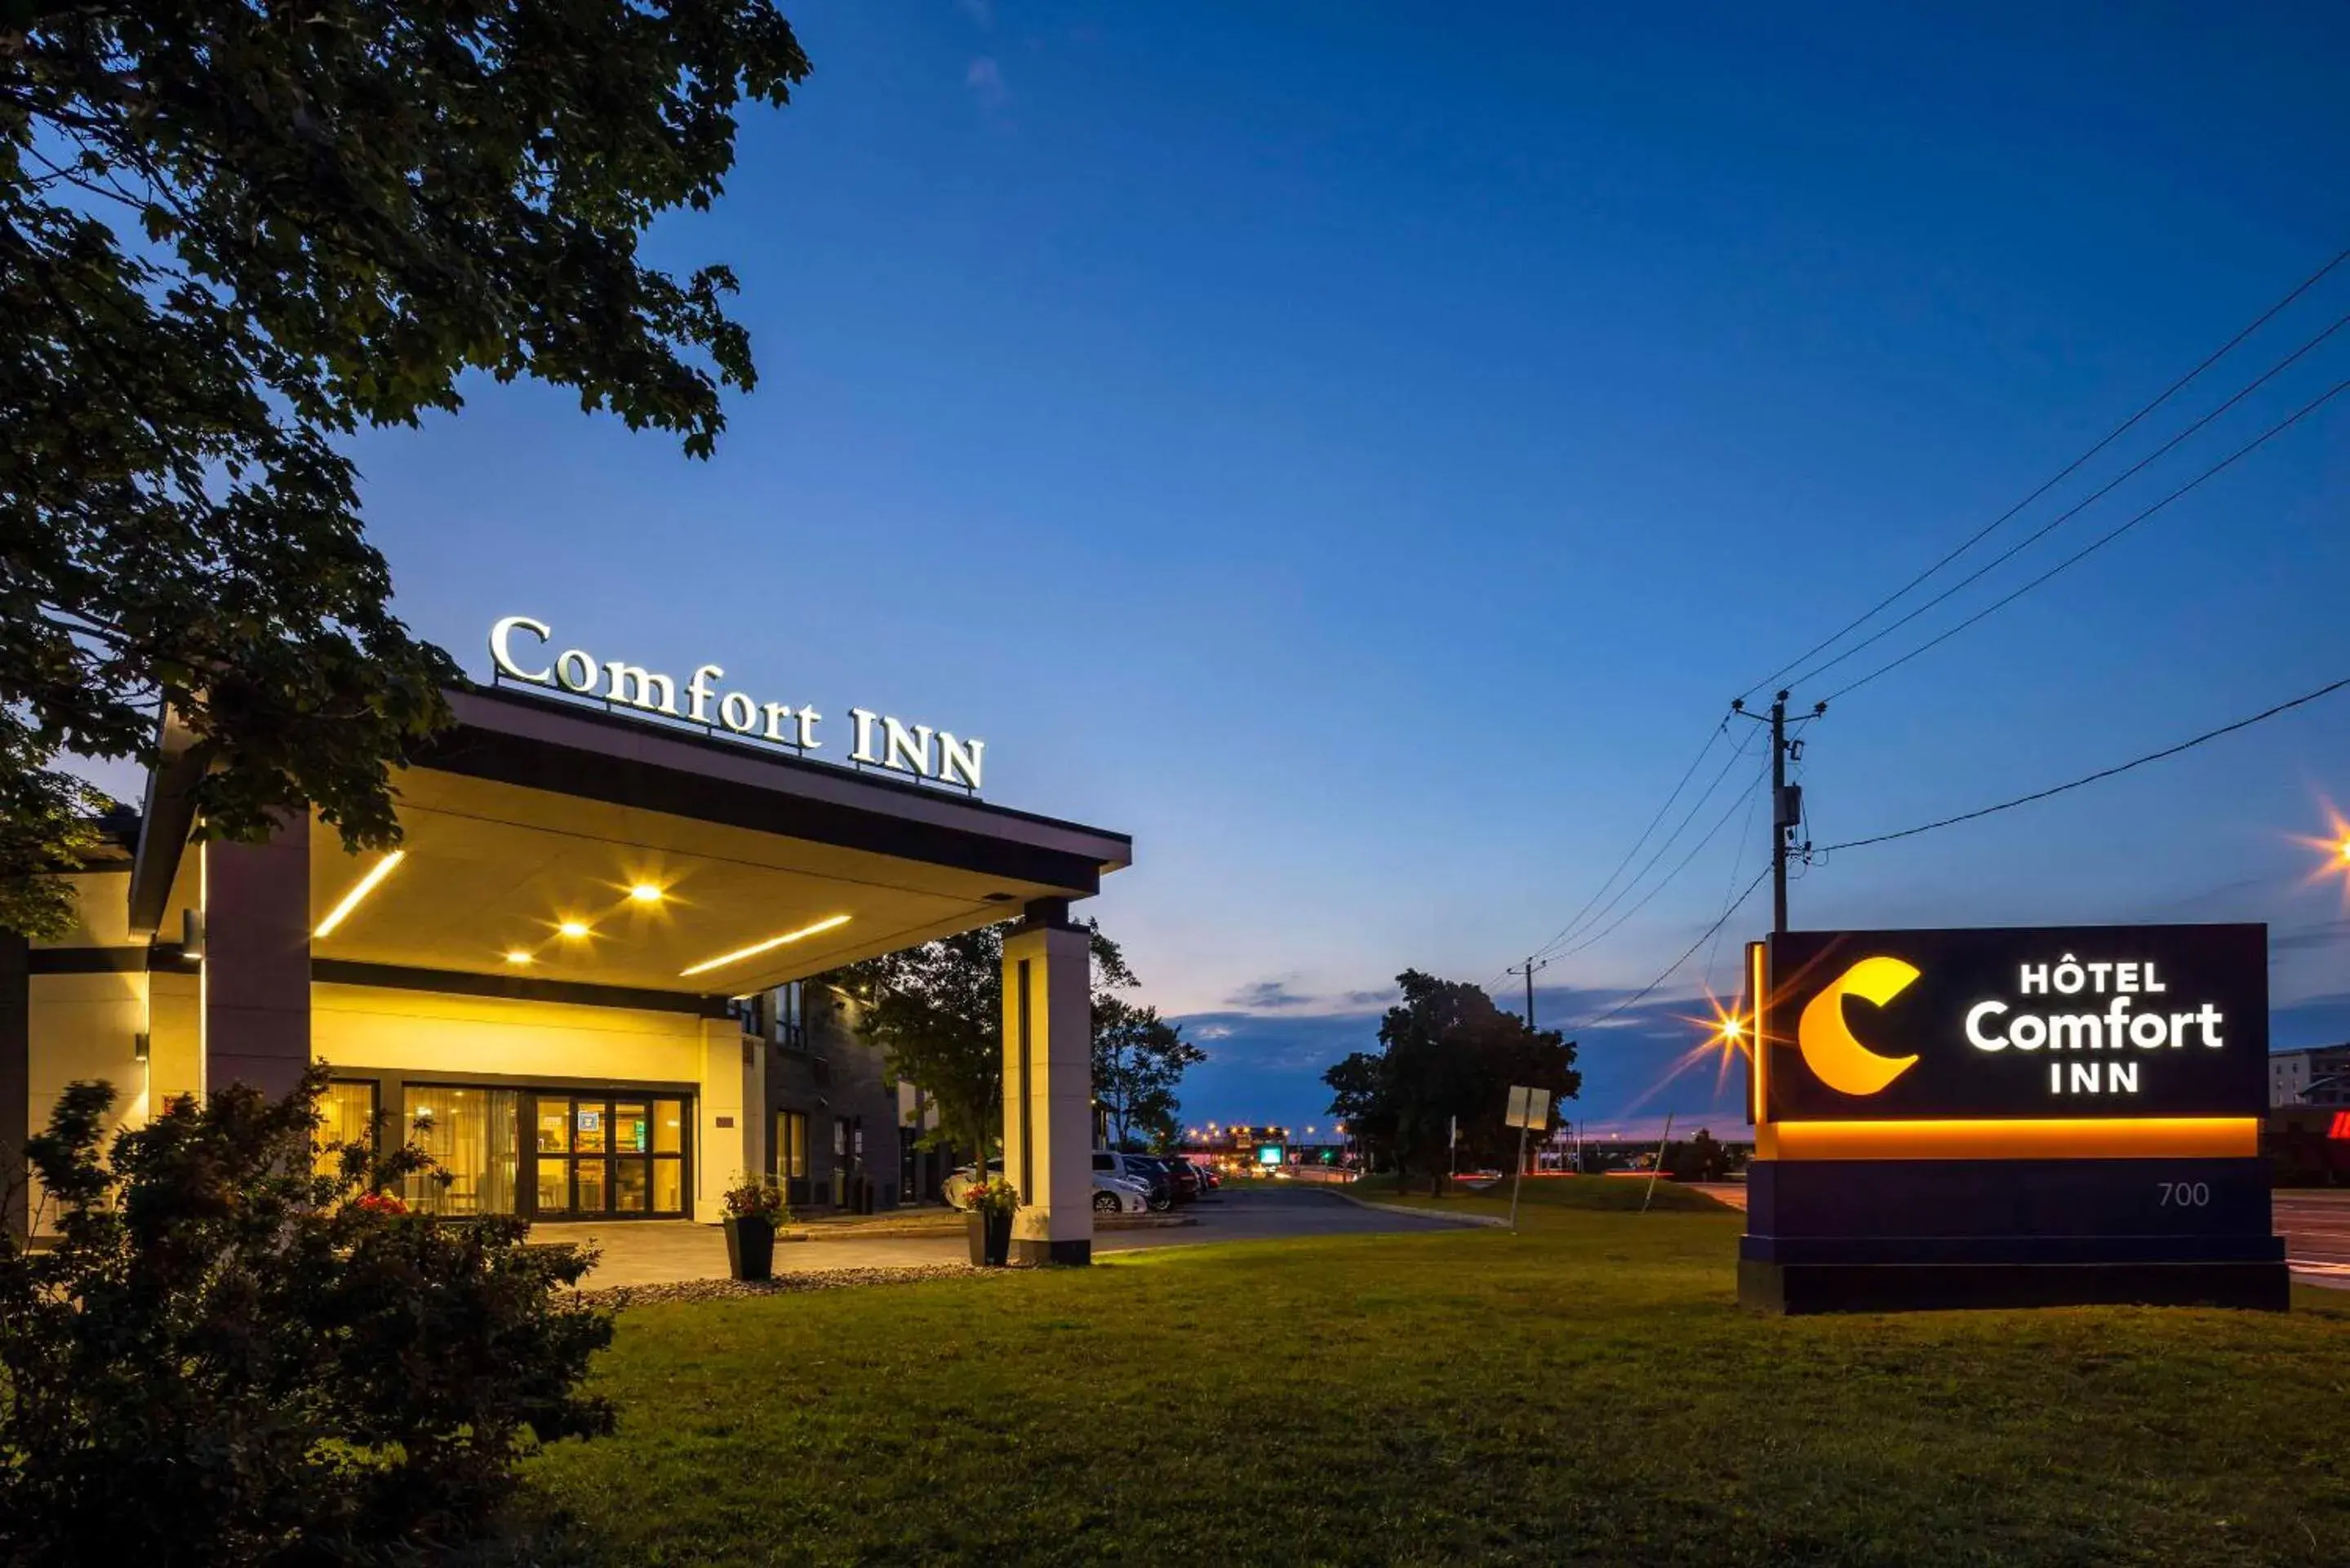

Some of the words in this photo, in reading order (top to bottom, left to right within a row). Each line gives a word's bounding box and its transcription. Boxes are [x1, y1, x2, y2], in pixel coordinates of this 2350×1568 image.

[489, 615, 823, 749] Comfort
[848, 707, 984, 789] INN
[2020, 953, 2166, 994] HÔTEL
[1965, 995, 2223, 1052] Comfort
[2050, 1062, 2138, 1094] INN
[2158, 1182, 2210, 1206] 700
